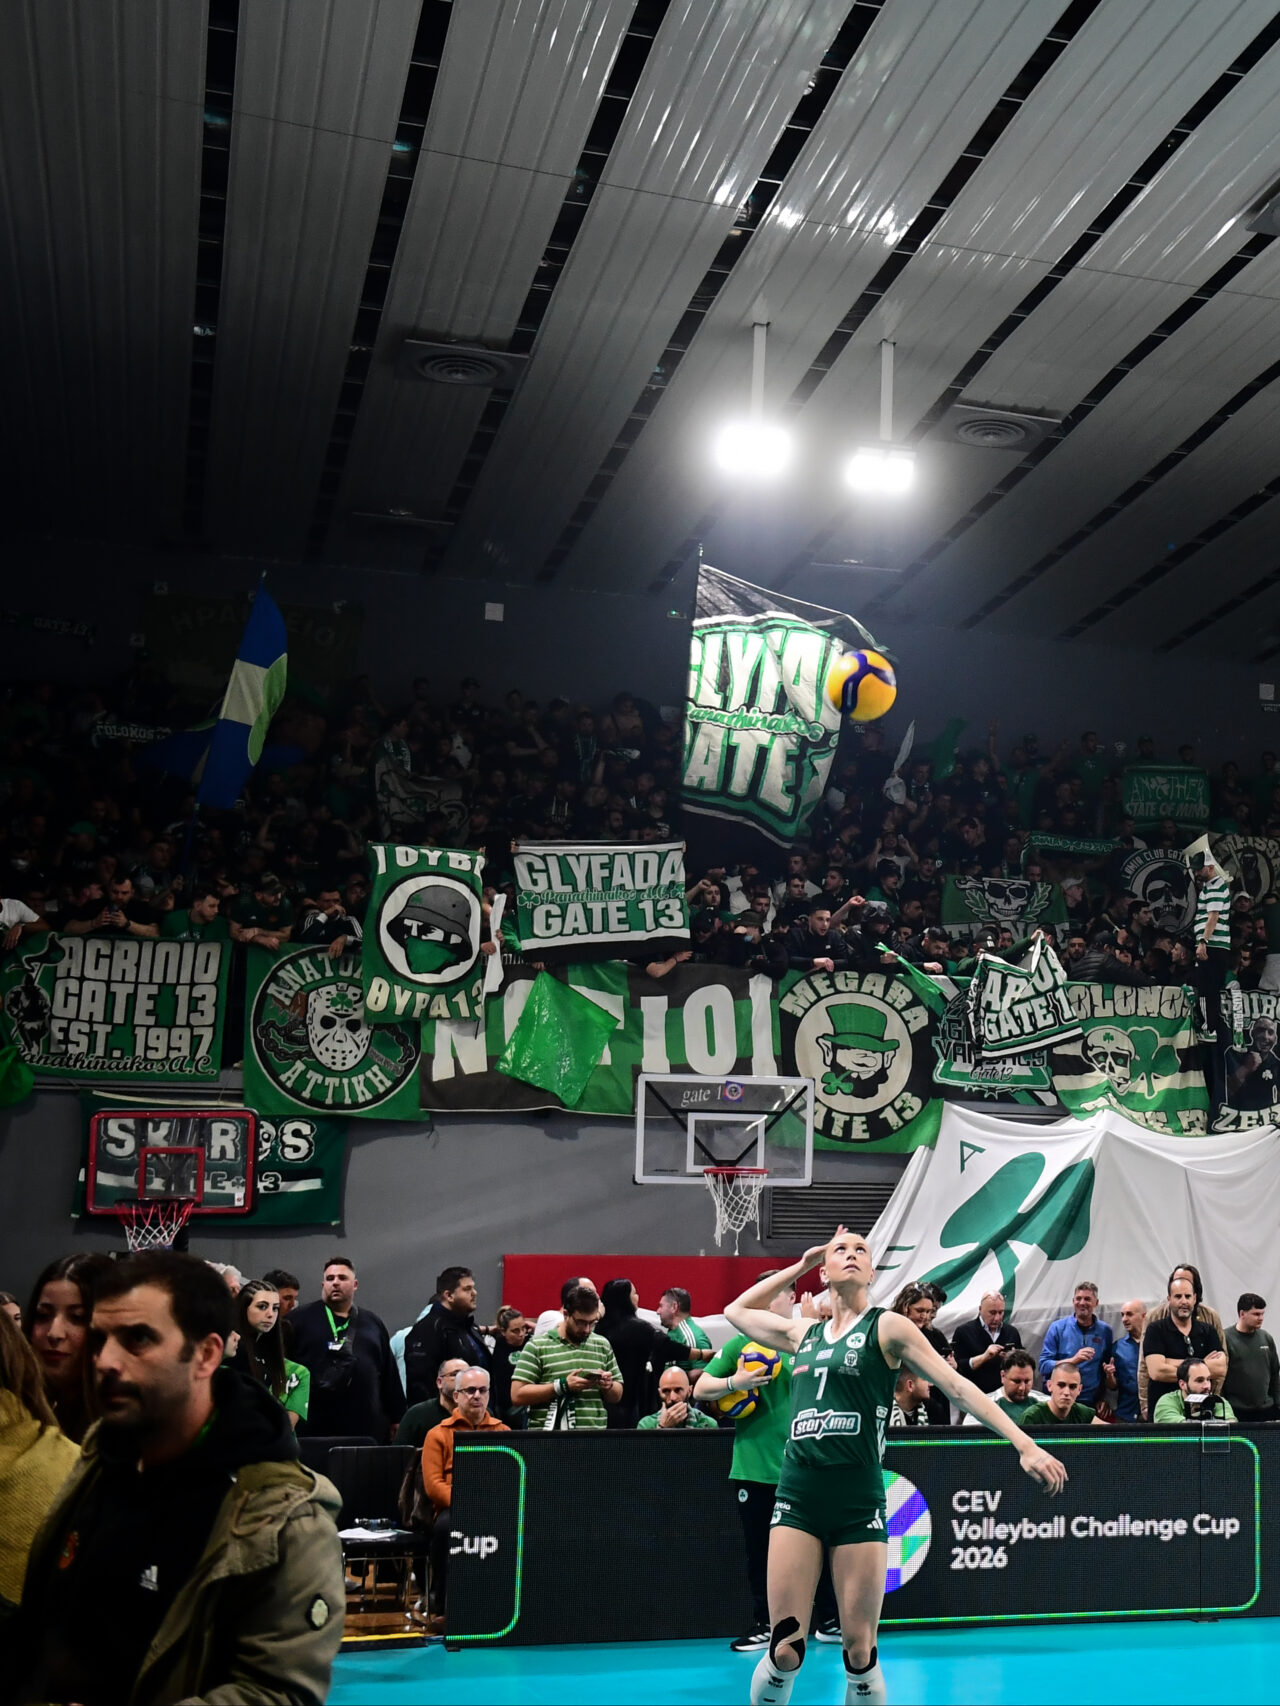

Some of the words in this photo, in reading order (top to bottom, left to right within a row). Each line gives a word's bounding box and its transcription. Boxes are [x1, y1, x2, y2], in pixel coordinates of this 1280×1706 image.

[1125, 801, 1156, 816] STATE
[1160, 802, 1176, 815] OF
[516, 849, 686, 893] GLYFADA
[533, 901, 630, 939] GATE
[637, 899, 685, 932] 13
[56, 937, 222, 984] AGRINIO
[51, 977, 168, 1028] GATE
[175, 983, 217, 1028] 13
[778, 970, 930, 1035] MEGARA
[985, 995, 1055, 1041] GATE
[1066, 984, 1192, 1021] OLONO
[50, 1021, 122, 1060] EST.
[134, 1025, 210, 1061] 1997
[682, 1087, 711, 1108] gate
[878, 1091, 923, 1131] 13
[103, 1117, 319, 1163] SKROS
[813, 1366, 829, 1401] 7
[952, 1489, 1002, 1513] CEV
[951, 1514, 1066, 1545] Volleyball
[1070, 1513, 1188, 1541] Challenge
[1192, 1513, 1240, 1539] Cup
[950, 1546, 1009, 1569] 2026
